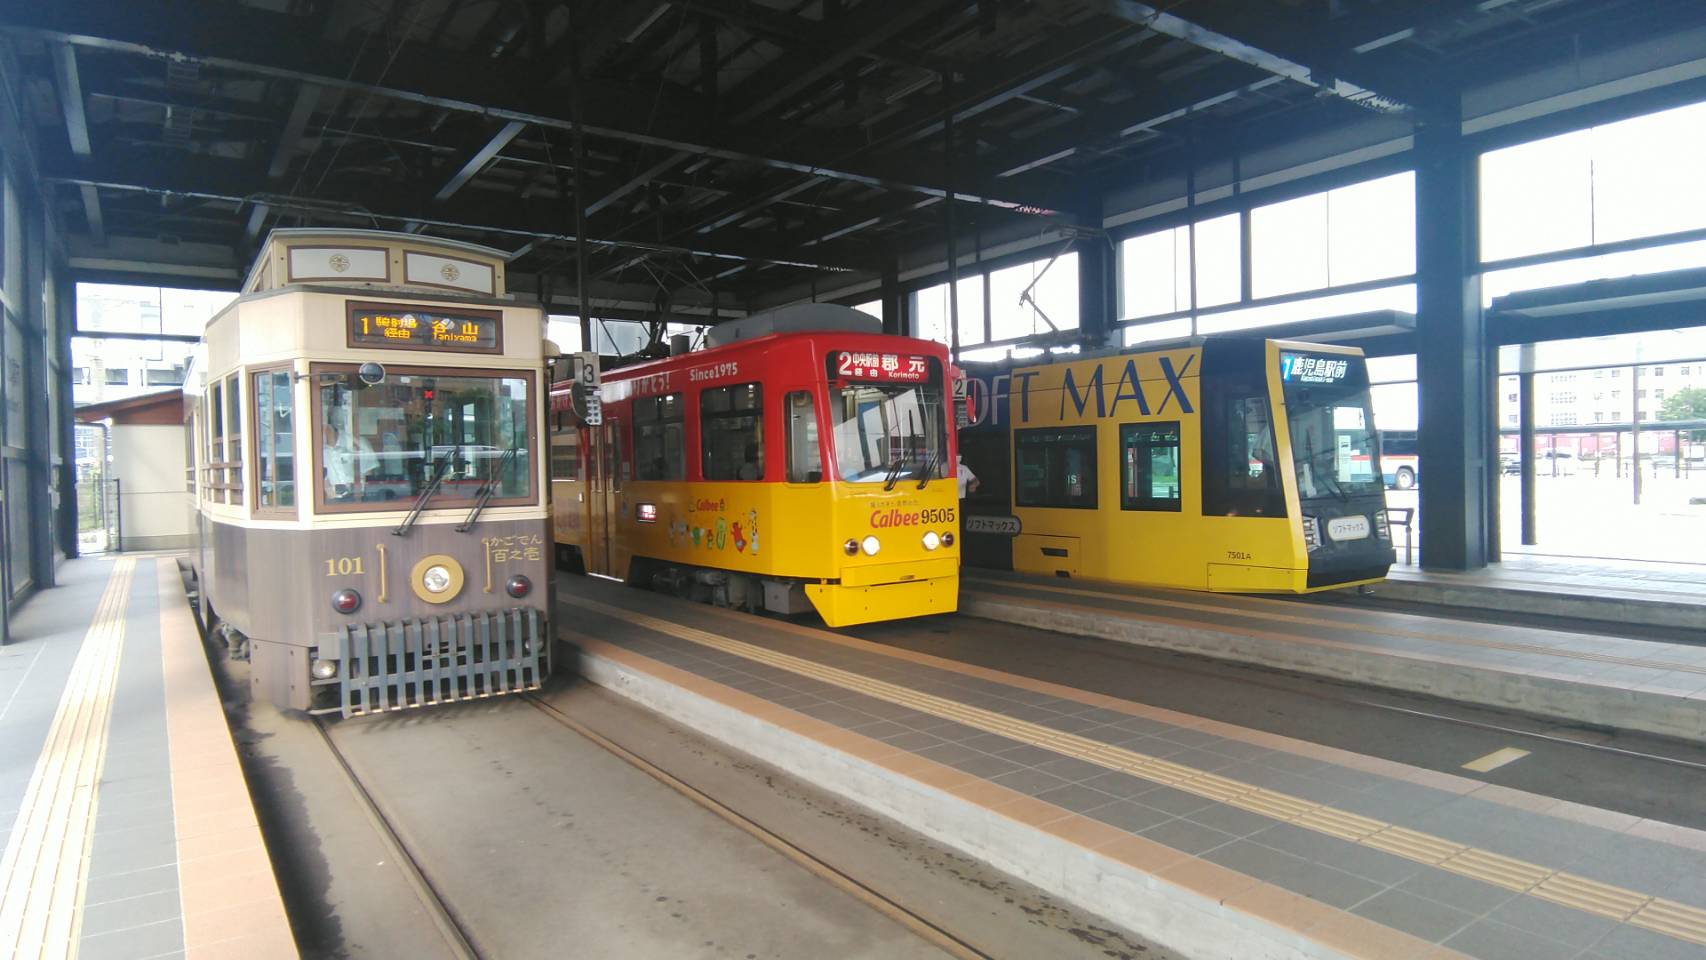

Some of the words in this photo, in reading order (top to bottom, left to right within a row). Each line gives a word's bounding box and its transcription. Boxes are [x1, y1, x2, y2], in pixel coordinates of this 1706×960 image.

[361, 317, 368, 335] 1
[690, 362, 738, 381] Since1975
[839, 352, 852, 375] 2
[1283, 358, 1291, 380] 1
[1291, 356, 1348, 379] 鹿児島駅前
[584, 364, 594, 383] 3
[955, 379, 963, 395] 2
[1060, 354, 1195, 421] MAX
[870, 508, 919, 528] Calbee
[921, 508, 955, 524] 9505
[490, 534, 543, 546] かごでん
[1227, 551, 1252, 560] 7501A
[325, 557, 365, 576] 101
